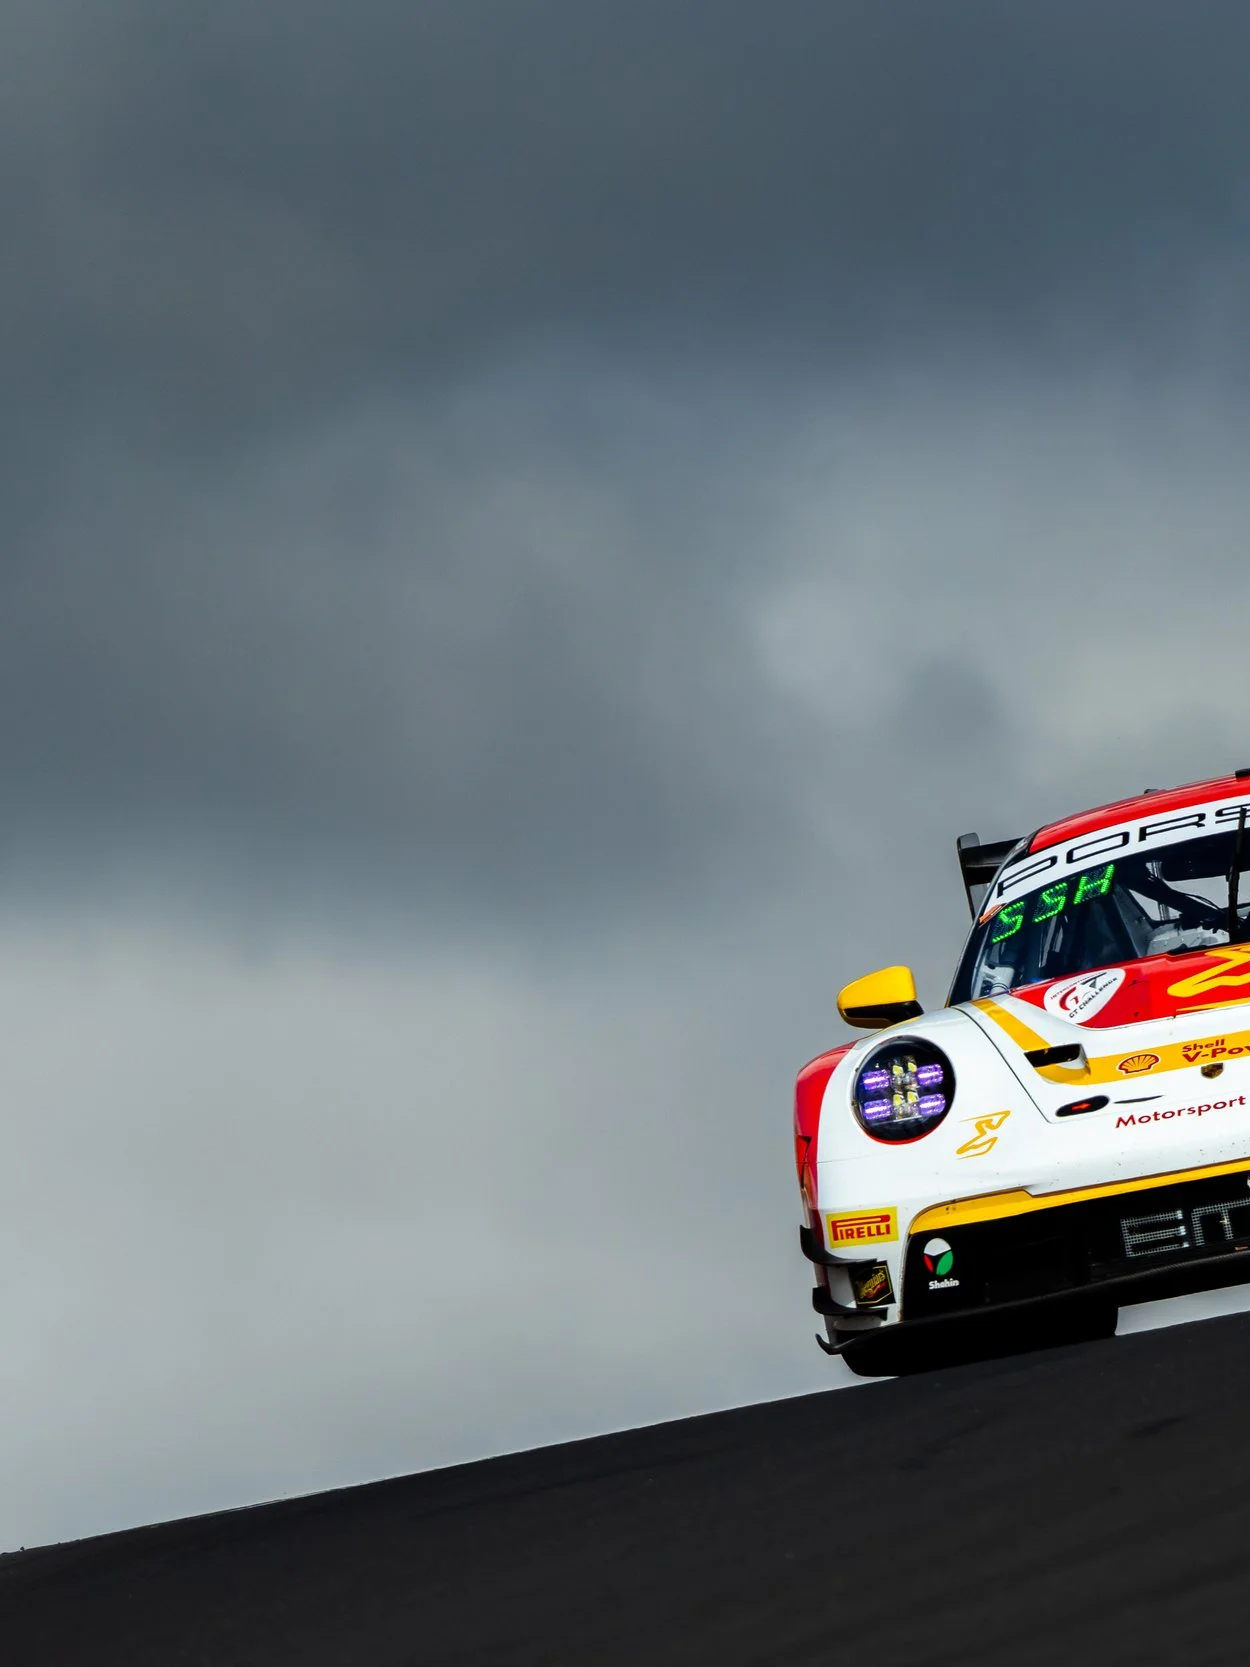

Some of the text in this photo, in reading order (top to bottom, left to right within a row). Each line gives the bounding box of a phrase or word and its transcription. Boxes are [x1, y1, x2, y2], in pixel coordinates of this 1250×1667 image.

[1182, 1039, 1225, 1052] Shell
[1115, 1095, 1246, 1128] Motorsport
[831, 1214, 891, 1241] PIRELLI
[928, 1278, 960, 1290] Shahin
